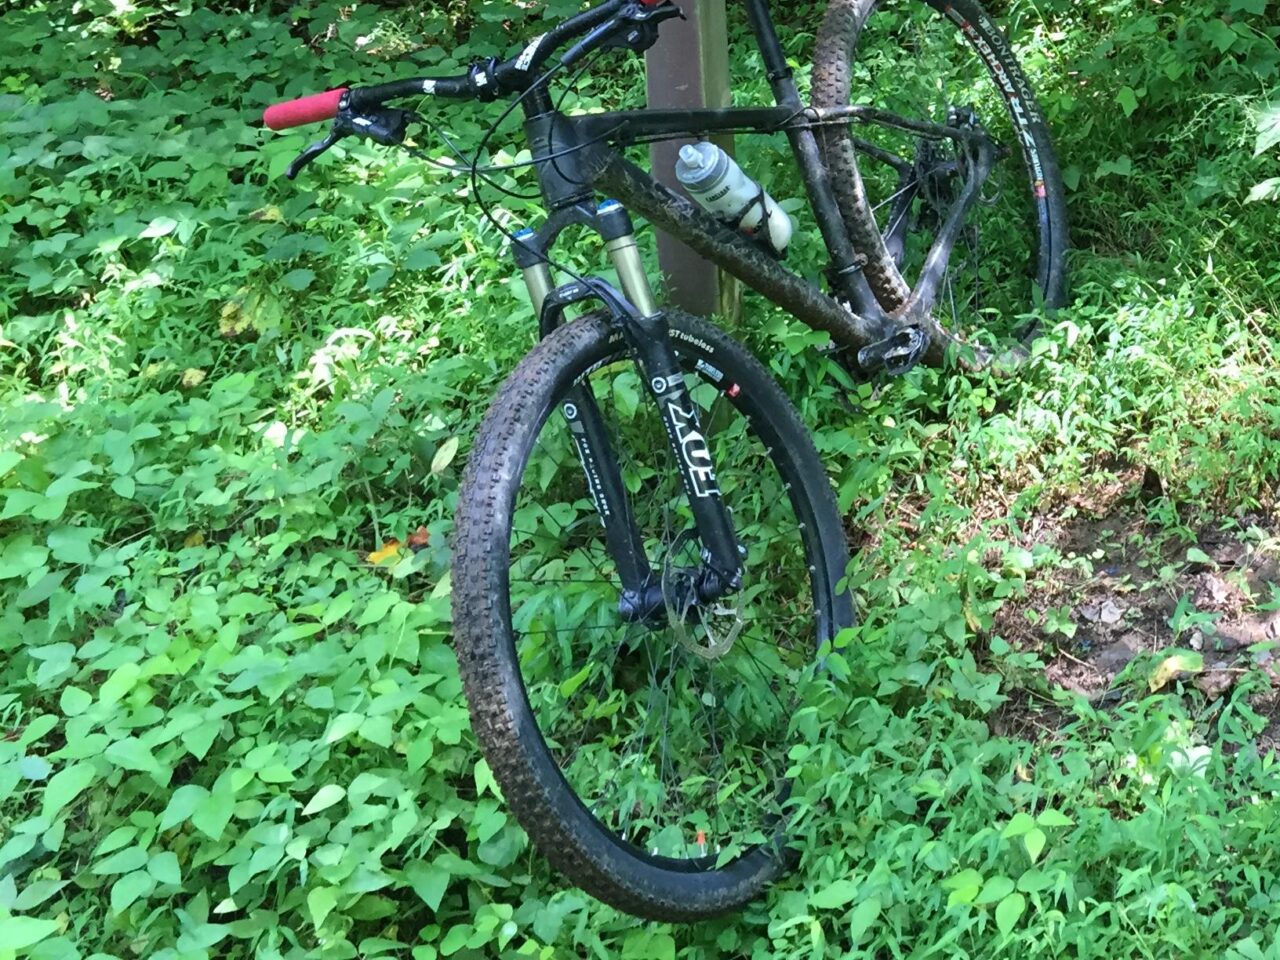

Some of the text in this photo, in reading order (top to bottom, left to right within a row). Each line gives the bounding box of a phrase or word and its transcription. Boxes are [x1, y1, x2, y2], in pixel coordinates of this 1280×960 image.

[986, 23, 1041, 123] BONTRAGER
[680, 332, 714, 353] tubeless
[668, 402, 722, 497] FOX
